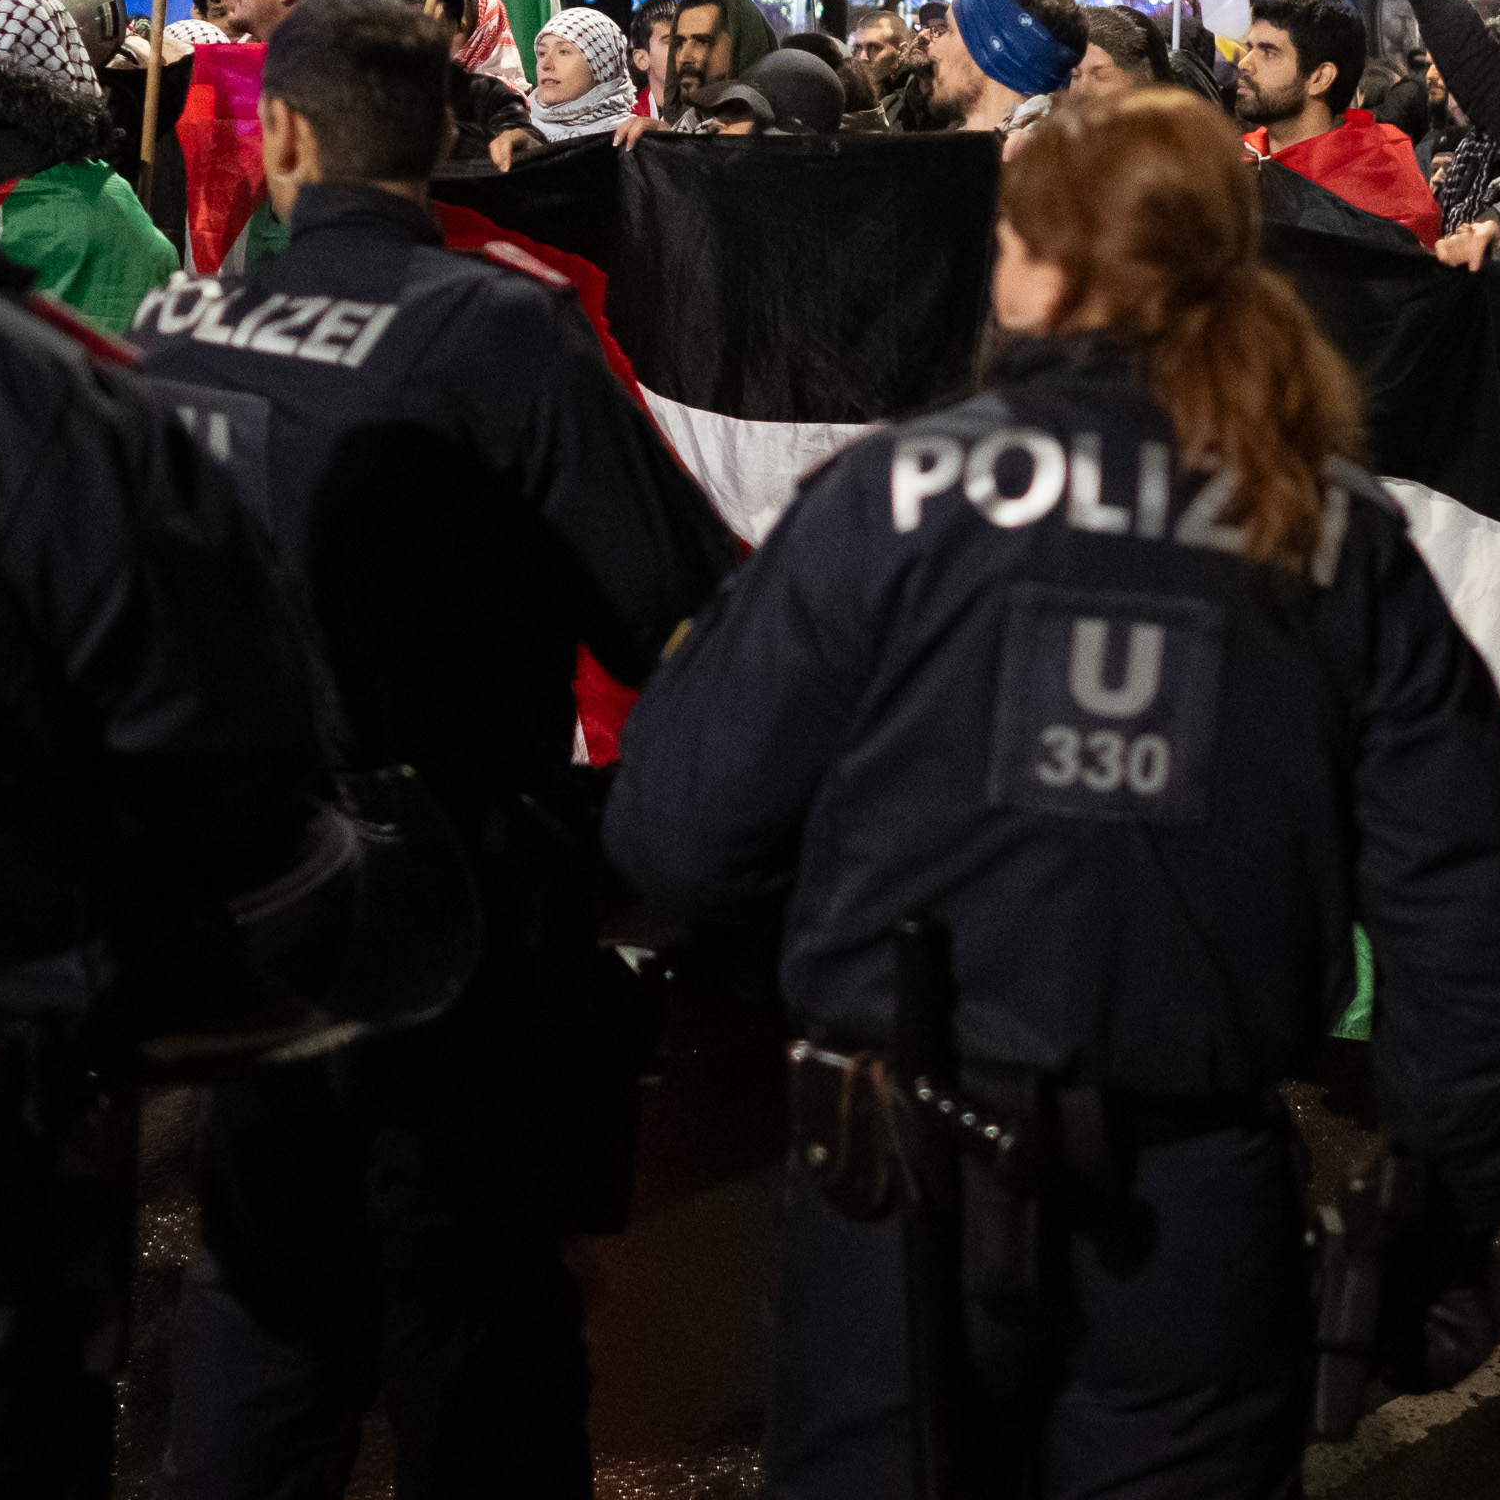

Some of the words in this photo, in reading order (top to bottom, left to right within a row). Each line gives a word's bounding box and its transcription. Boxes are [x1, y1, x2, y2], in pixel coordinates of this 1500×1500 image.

[891, 428, 1353, 587] POLIZI
[1068, 617, 1166, 720] U
[1036, 725, 1172, 795] 330
